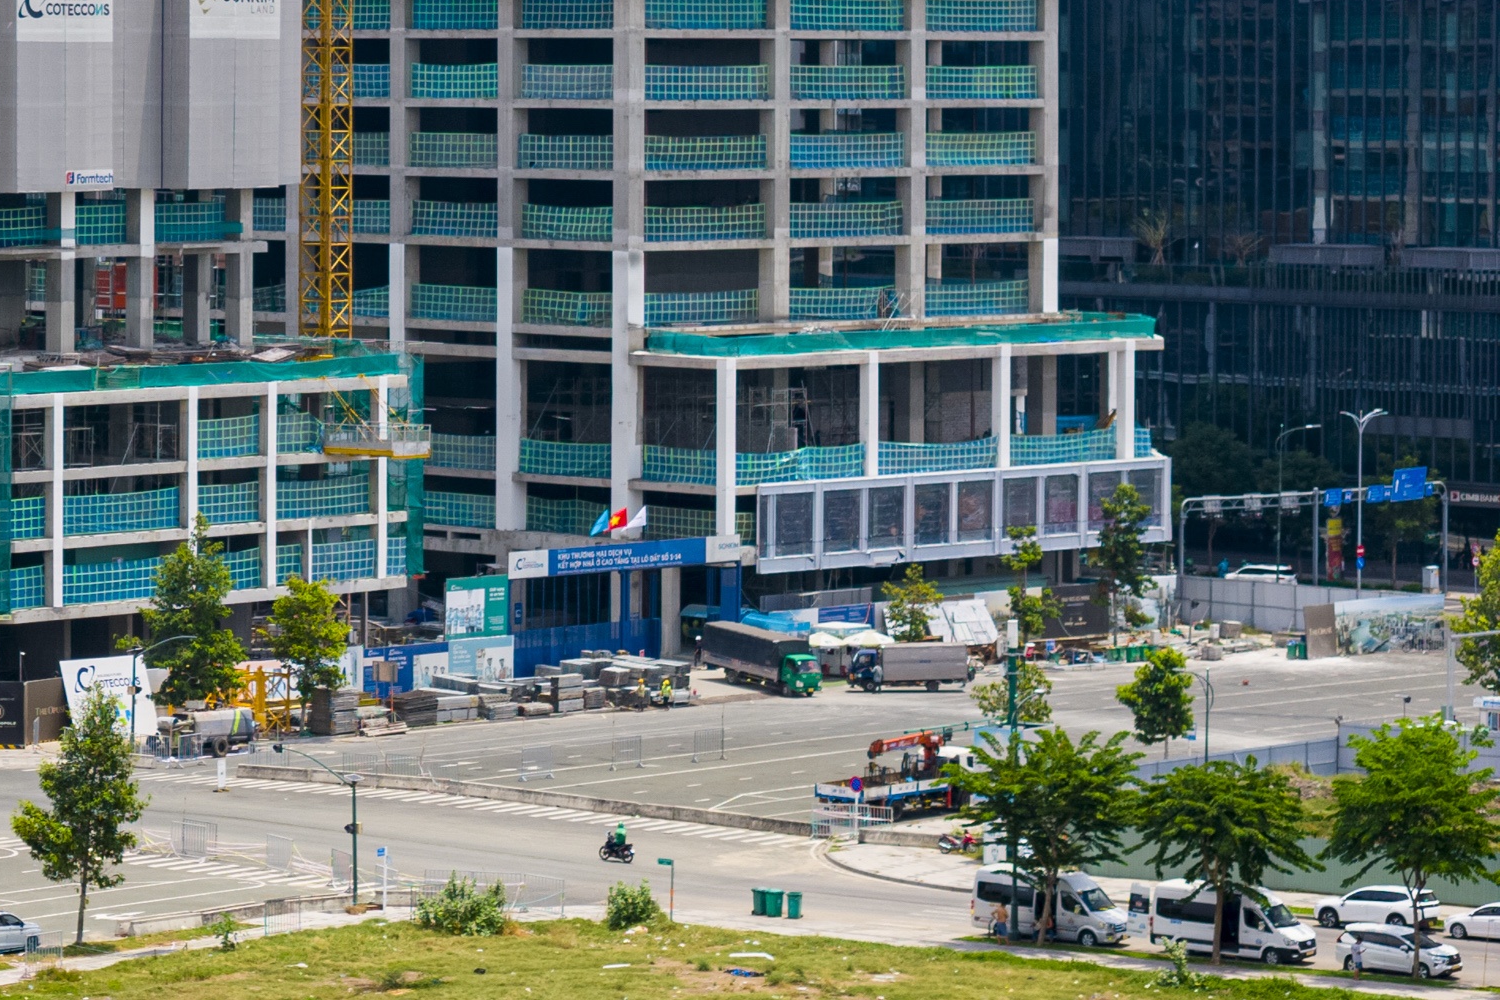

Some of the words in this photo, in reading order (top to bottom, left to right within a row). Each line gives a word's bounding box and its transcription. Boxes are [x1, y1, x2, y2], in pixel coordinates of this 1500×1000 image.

[46, 3, 110, 16] COTECCONS
[250, 5, 275, 14] LAND
[76, 172, 114, 184] Formtech
[557, 552, 570, 560] KHU
[94, 677, 140, 689] OTECCOS
